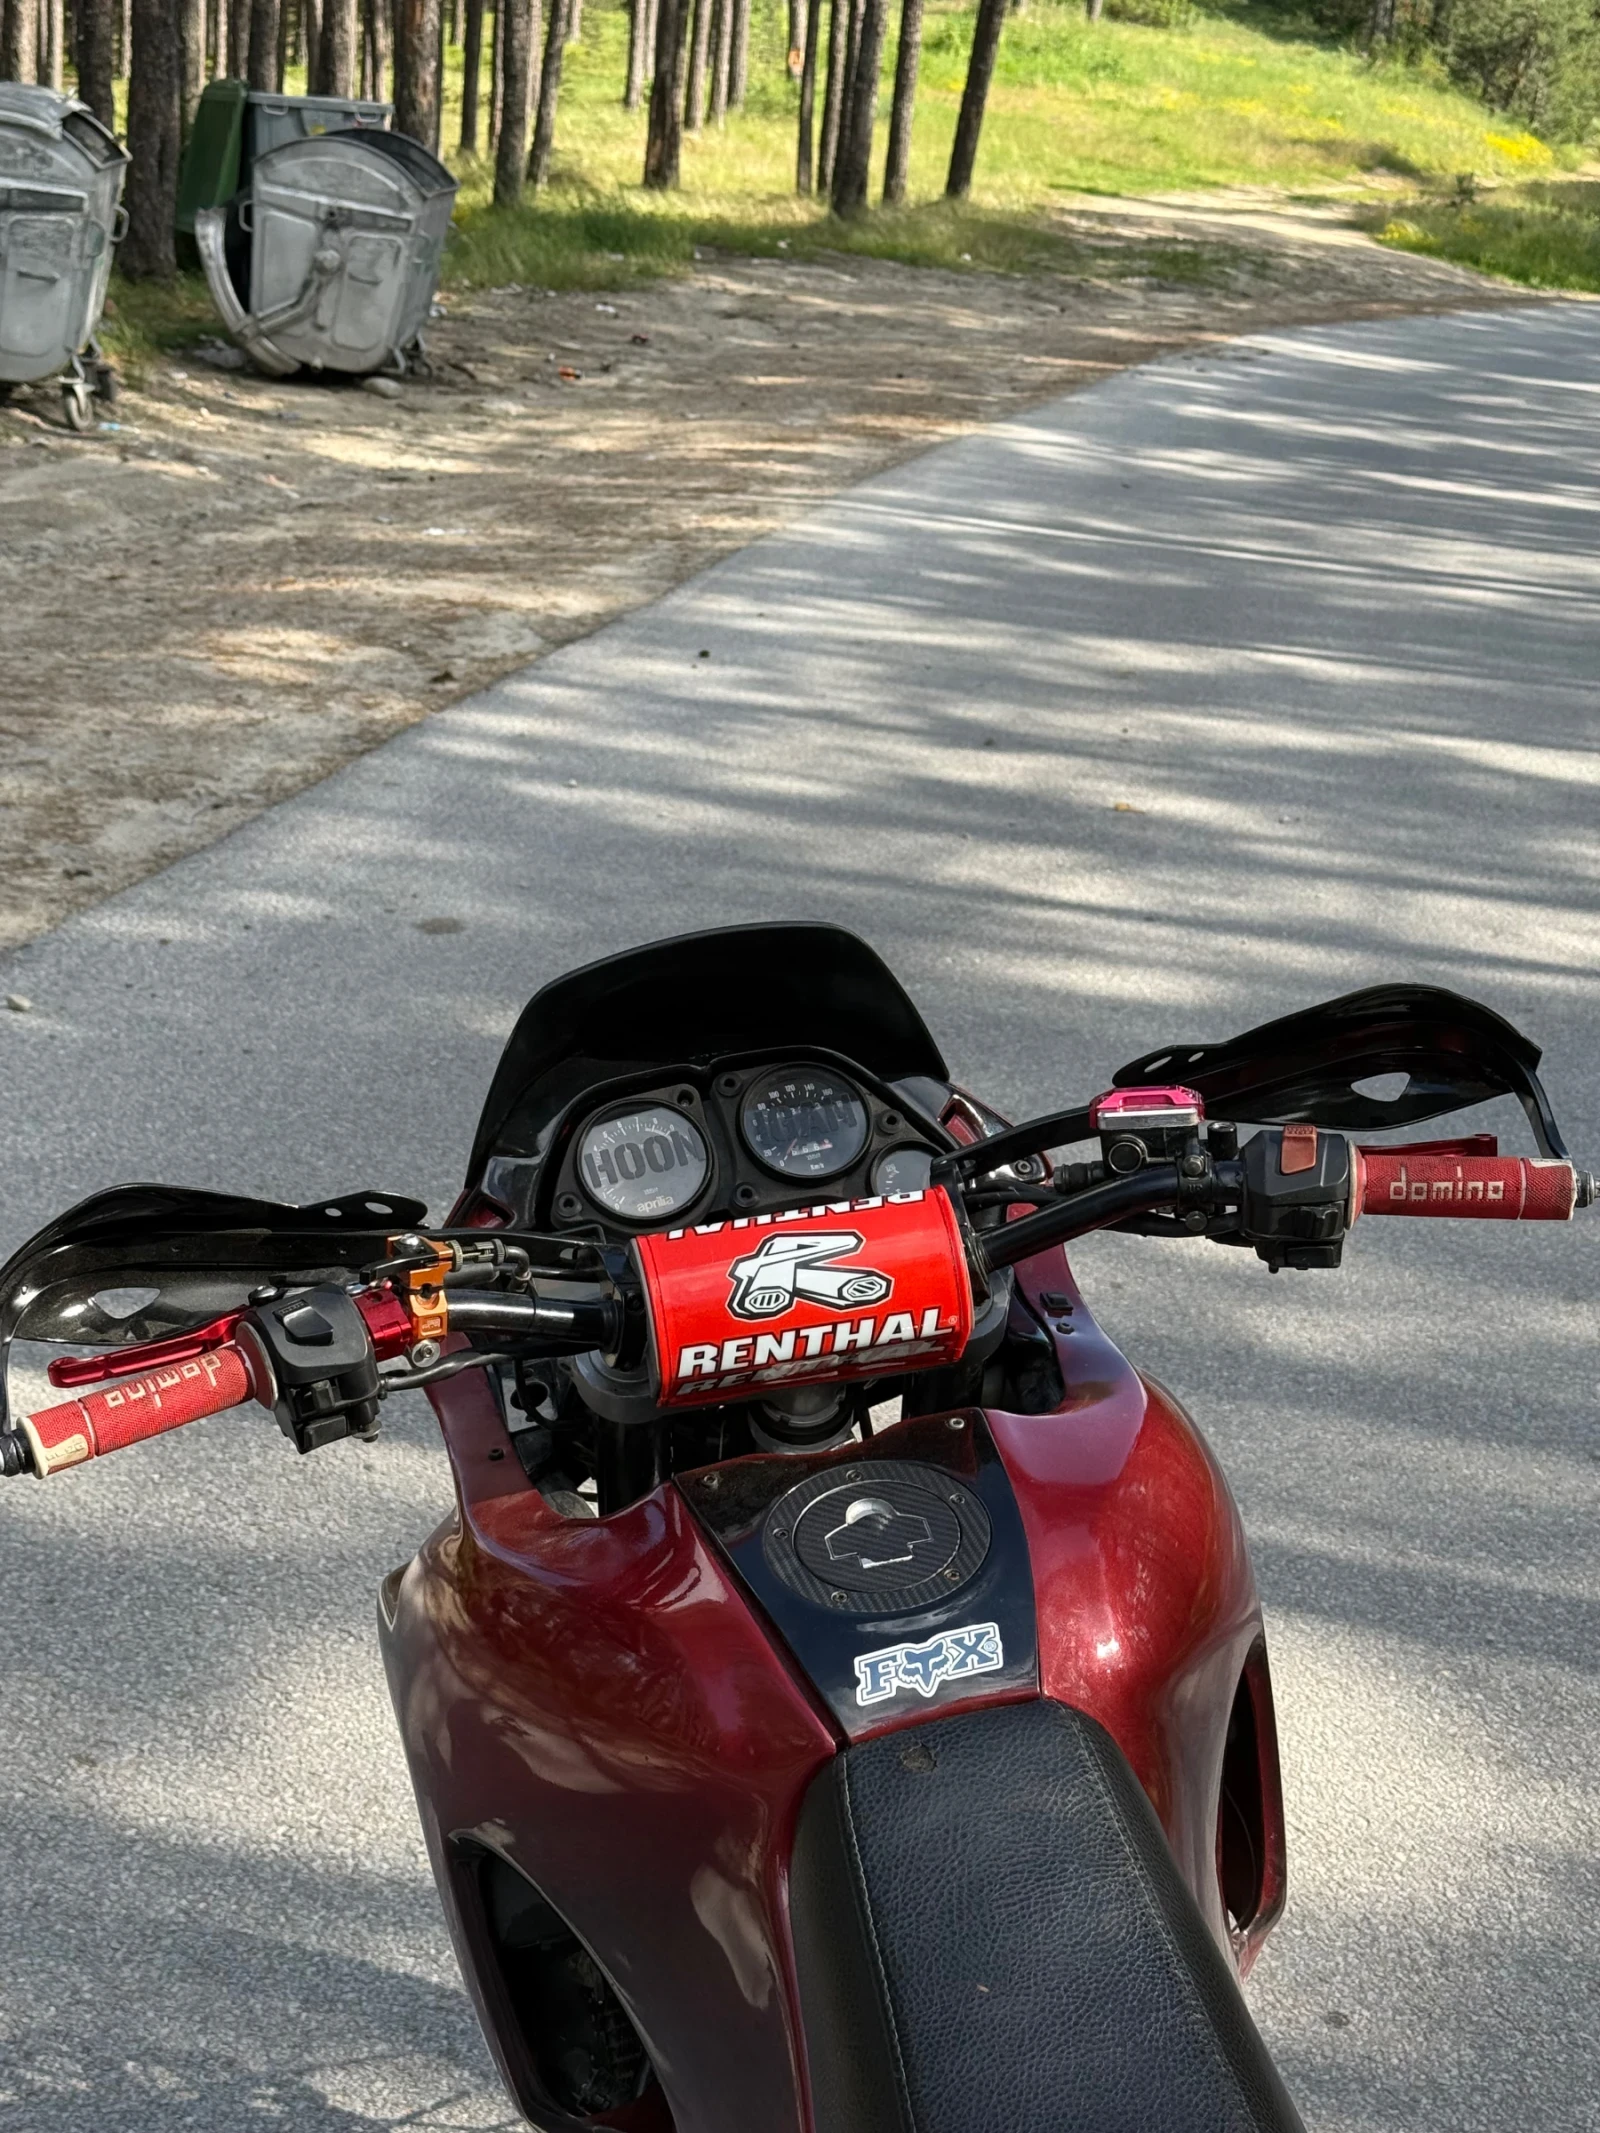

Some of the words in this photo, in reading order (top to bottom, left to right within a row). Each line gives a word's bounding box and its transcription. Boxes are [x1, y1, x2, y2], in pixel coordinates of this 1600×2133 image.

[584, 1126, 705, 1189] HOON
[1390, 1166, 1504, 1200] domino
[636, 1195, 674, 1213] aprilia
[678, 1309, 952, 1379] RENTHAL
[104, 1354, 221, 1408] domino
